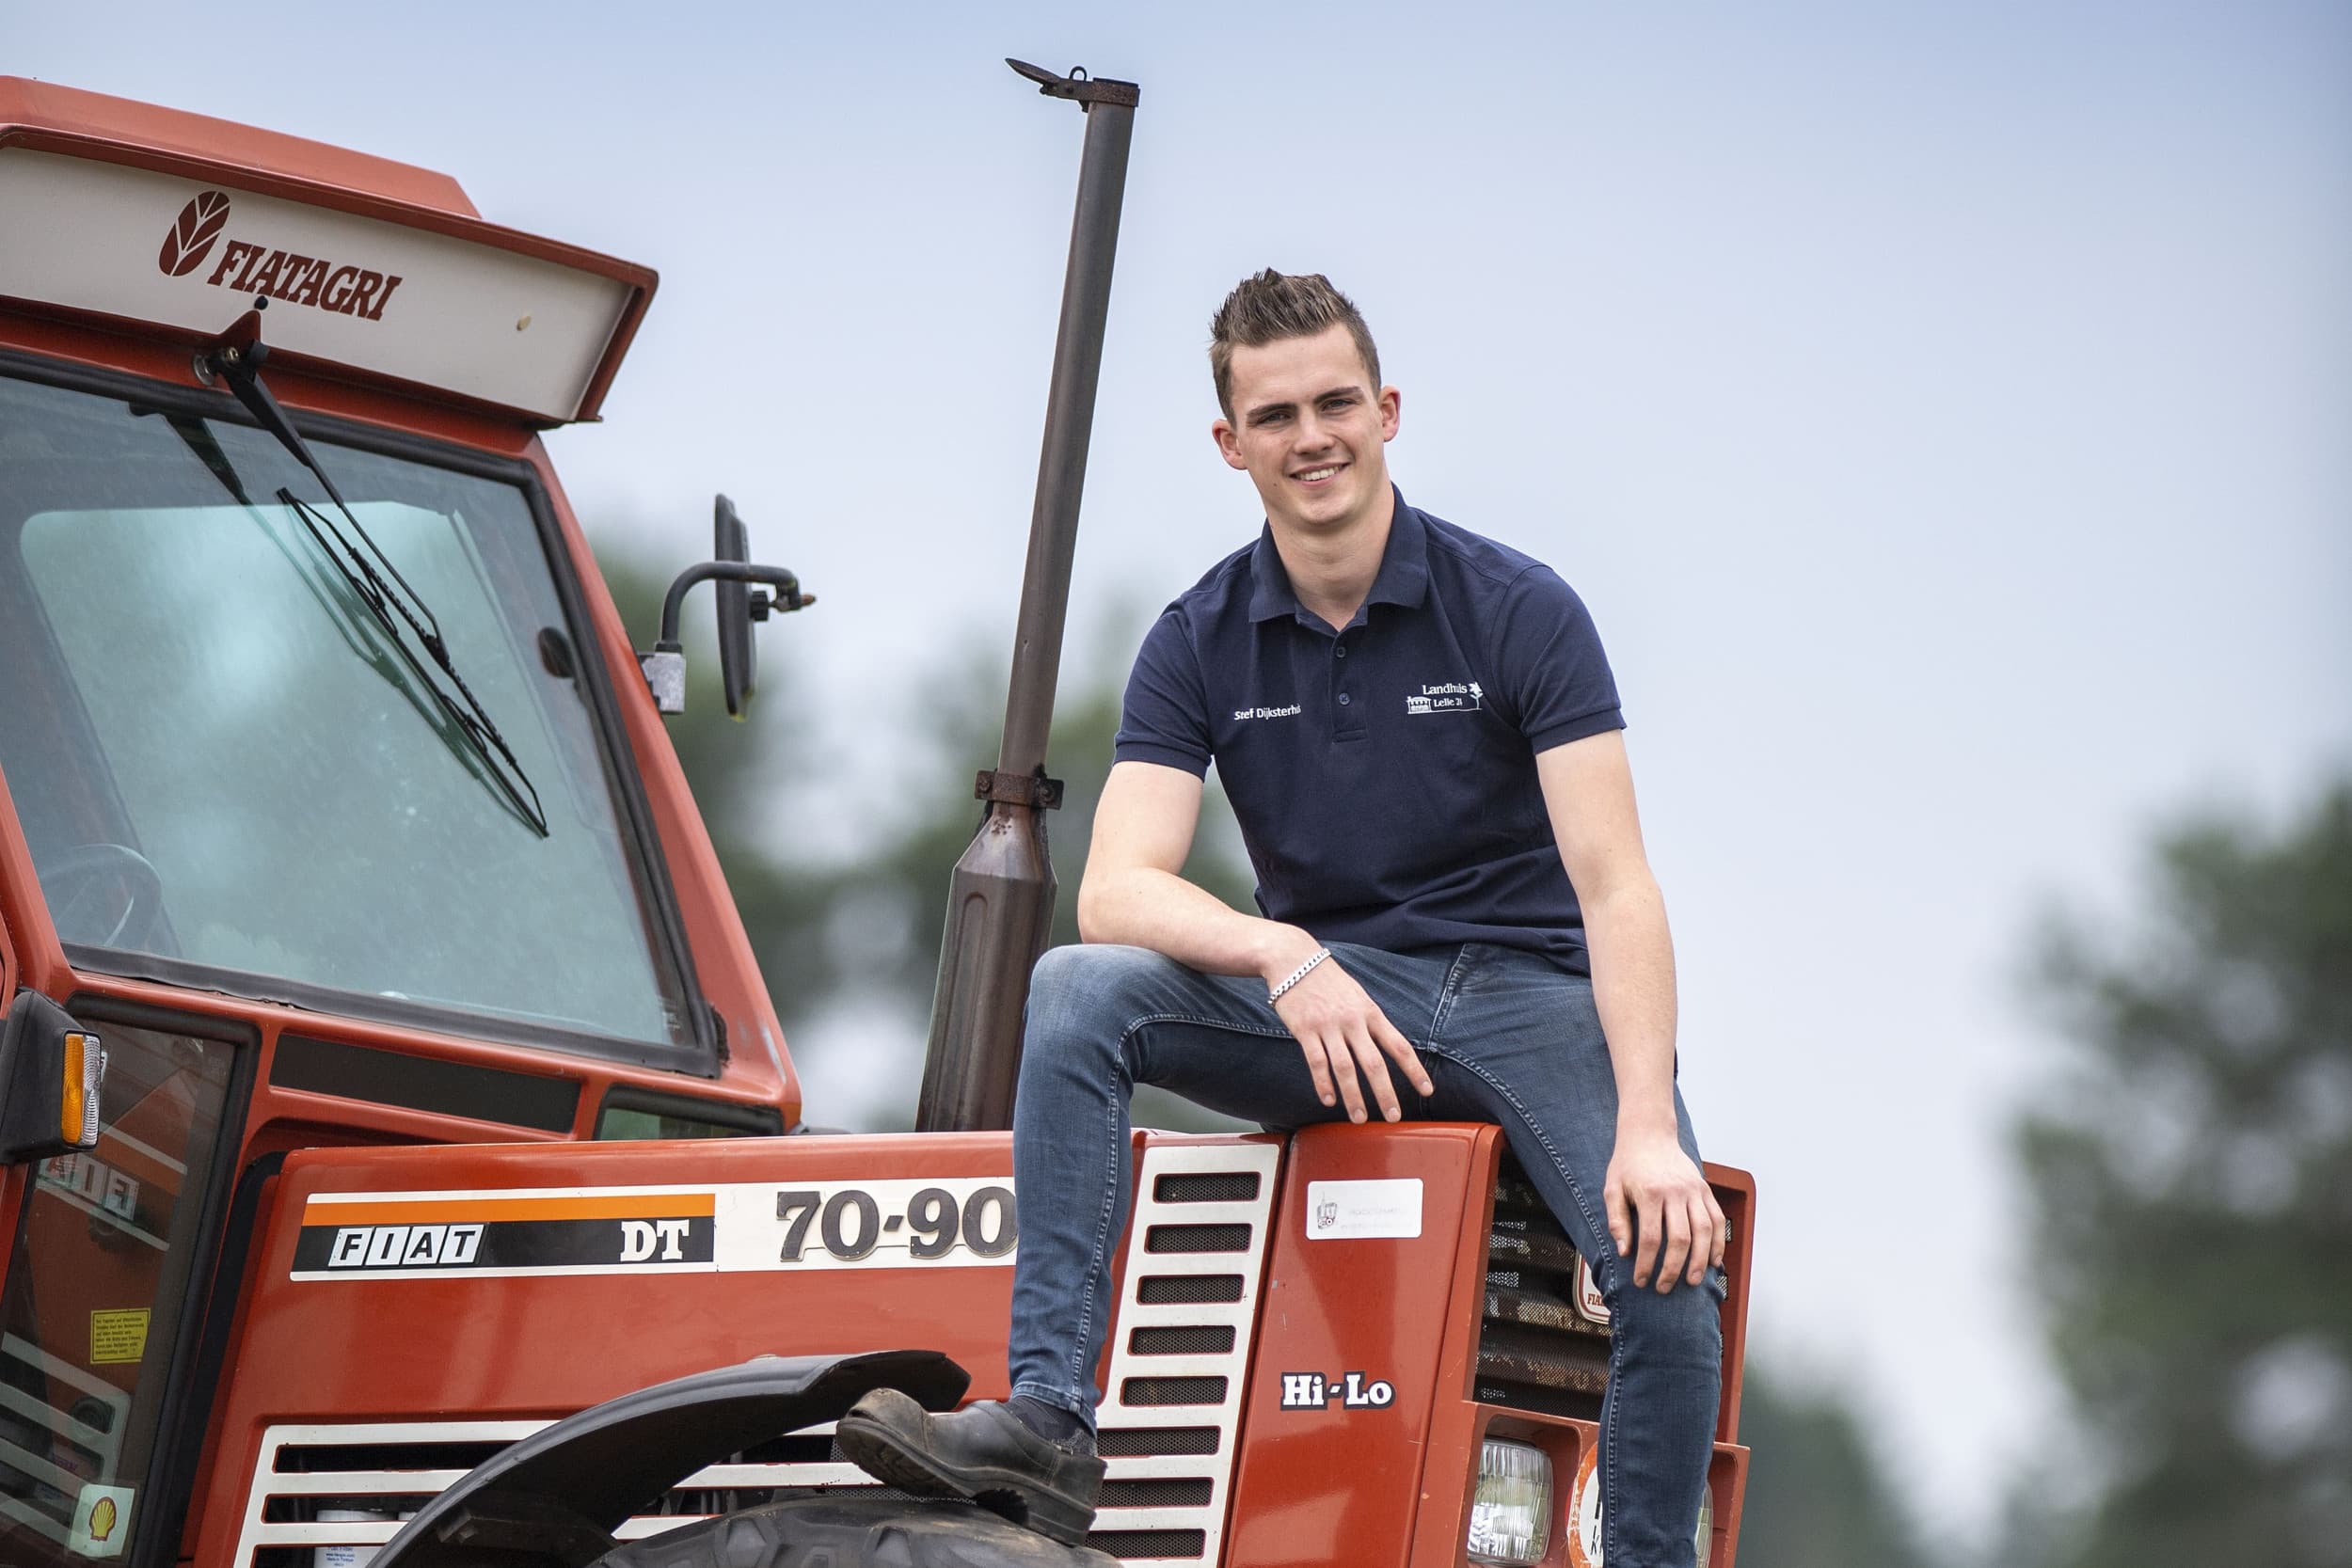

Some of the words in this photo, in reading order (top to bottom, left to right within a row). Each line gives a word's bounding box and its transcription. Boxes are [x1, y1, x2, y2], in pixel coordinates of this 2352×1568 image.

[207, 240, 403, 321] FIATAGRI
[1233, 707, 1254, 721] Stef
[337, 1228, 479, 1262] FIAT
[620, 1219, 690, 1262] DT
[776, 1186, 1019, 1262] 70-90
[1282, 1374, 1392, 1406] Hi-Lo
